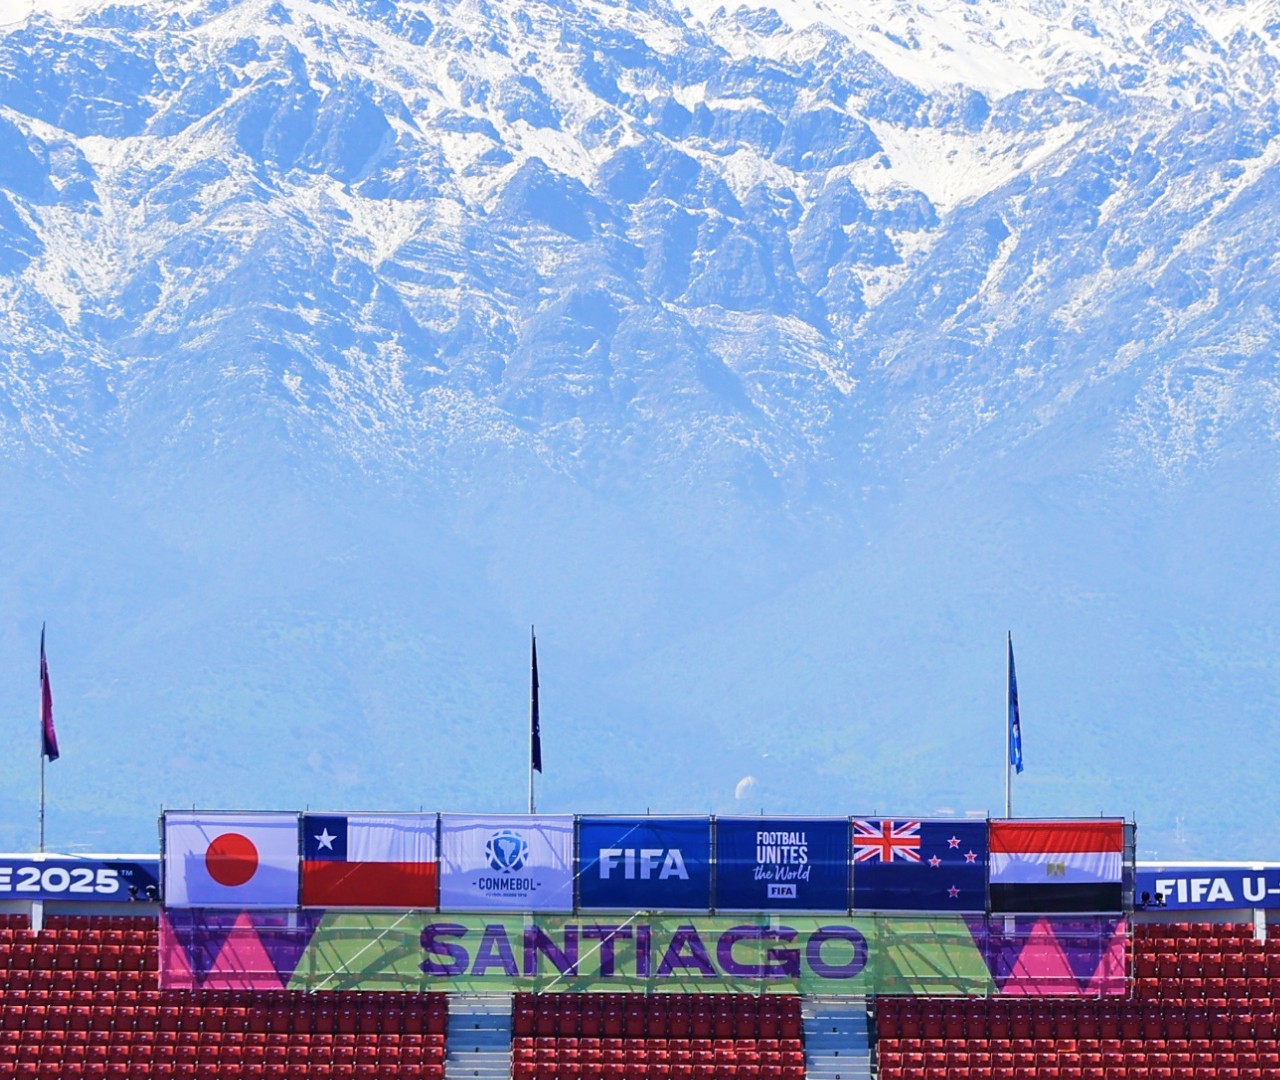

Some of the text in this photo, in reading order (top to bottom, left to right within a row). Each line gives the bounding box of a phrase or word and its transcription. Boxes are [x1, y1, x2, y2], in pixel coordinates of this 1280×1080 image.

[757, 832, 807, 848] FOOTBALL
[599, 849, 688, 879] FIFA
[757, 846, 807, 866] UNITES
[754, 863, 811, 881] the World
[772, 887, 792, 895] FIFA
[1156, 878, 1234, 903] FIFA
[417, 924, 871, 980] SANTIAGO
